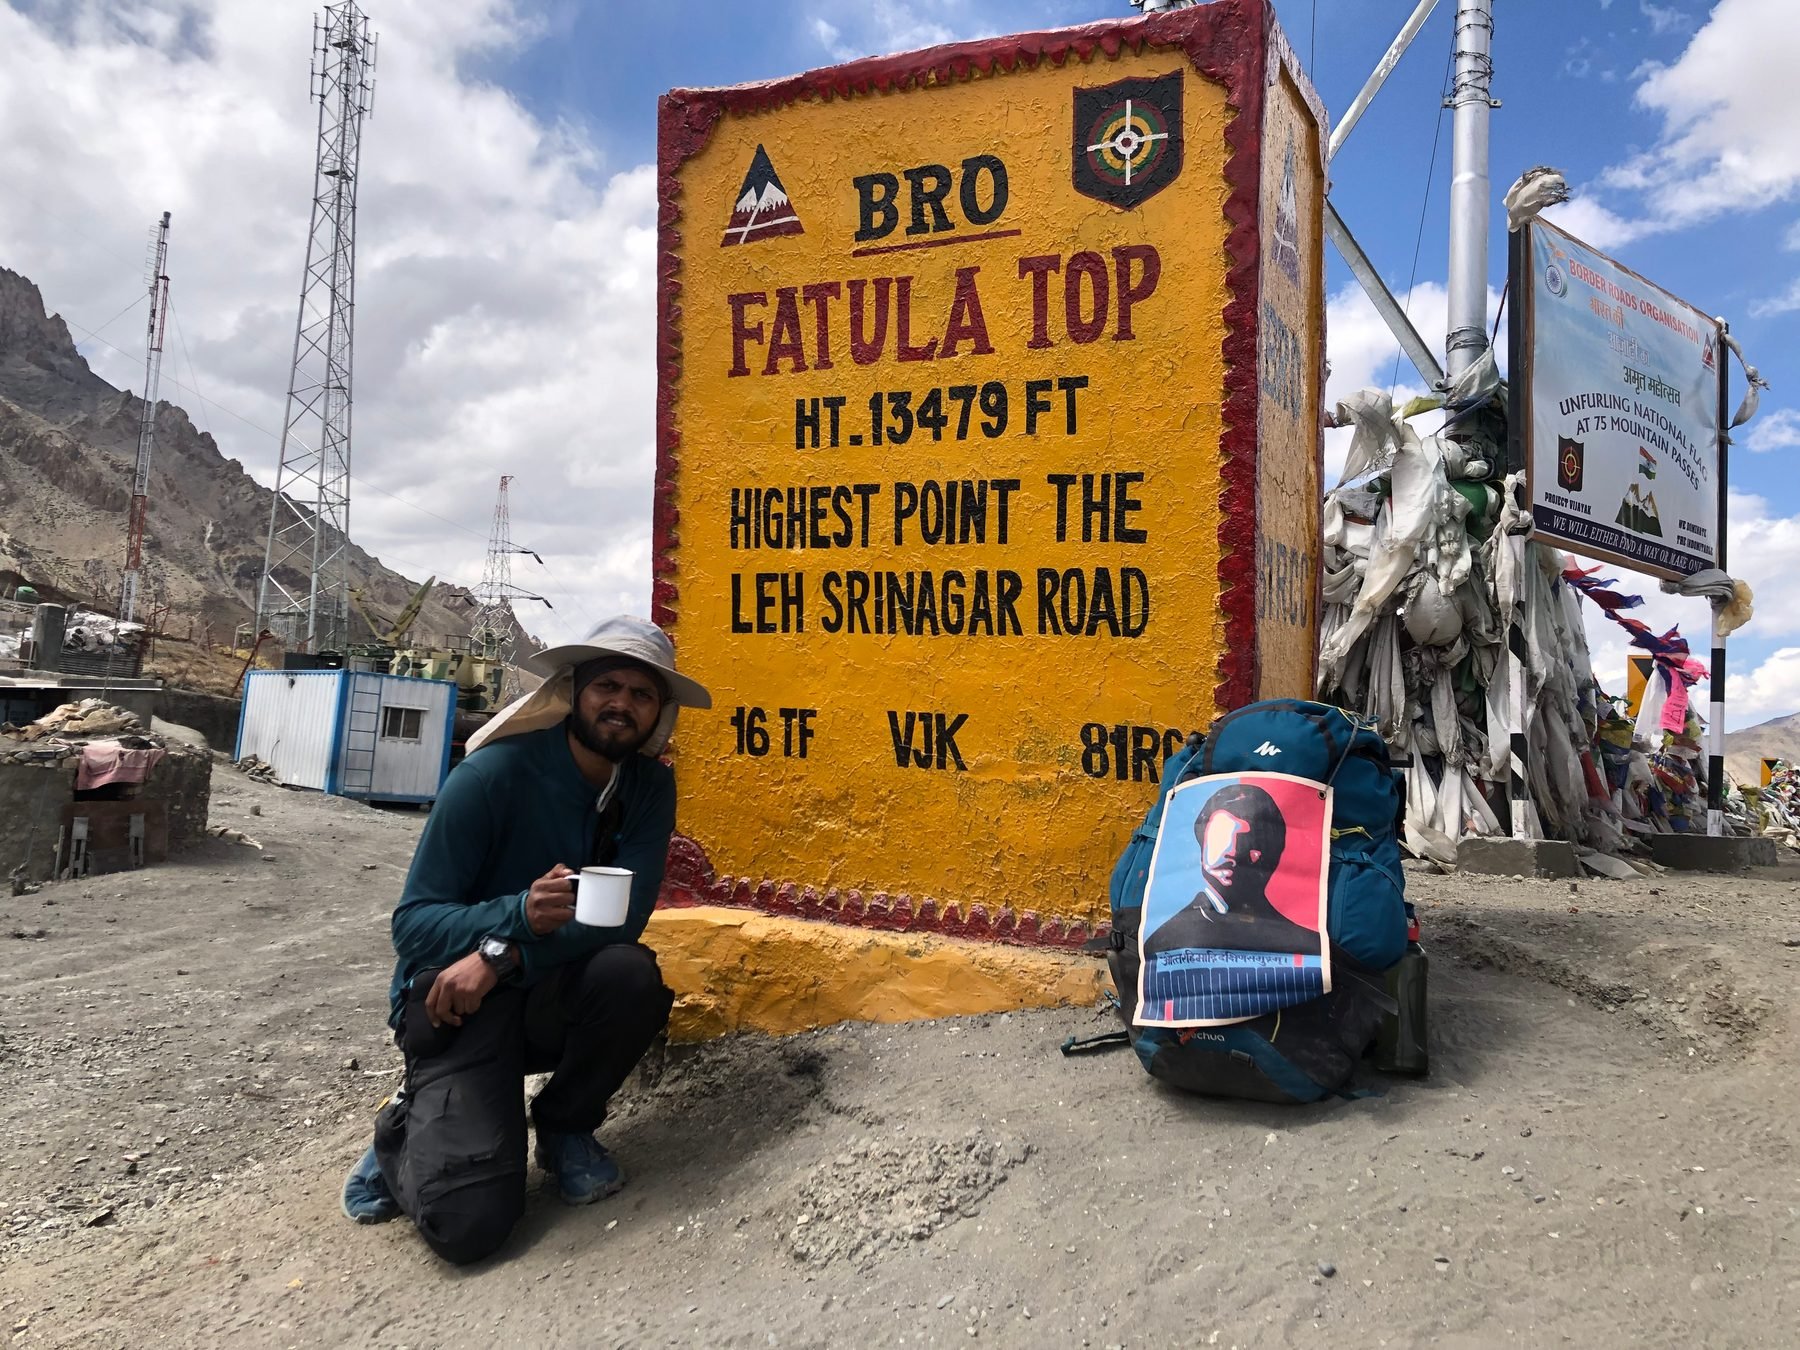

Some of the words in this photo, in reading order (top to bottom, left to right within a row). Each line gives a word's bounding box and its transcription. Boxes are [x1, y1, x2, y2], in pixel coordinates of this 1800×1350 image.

[853, 154, 1009, 242] BRO
[727, 266, 995, 378] FATULA
[1018, 244, 1162, 349] TOP
[1569, 258, 1606, 293] BORDER
[1608, 281, 1638, 310] ROADS
[1639, 299, 1699, 344] ORGANISATION
[1025, 375, 1089, 436] FT
[1623, 366, 1646, 395] अमृत
[1647, 374, 1681, 407] महोत्सव
[1559, 392, 1630, 416] UNFURLING
[1633, 401, 1687, 450] NATIONAL
[1688, 442, 1708, 482] FLAG
[1576, 417, 1591, 436] AT
[1594, 415, 1607, 431] 75
[1610, 415, 1669, 454] MOUNTAIN
[1671, 446, 1700, 491] PASSES
[730, 483, 881, 549] HIGHEST
[894, 479, 1021, 546] POINT
[1046, 471, 1148, 544] THE
[1544, 492, 1569, 509] PROJECT
[1569, 499, 1592, 515] VIJAYAK
[1552, 514, 1567, 531] WE
[1568, 519, 1588, 538] WILL
[1589, 526, 1619, 548] EITHER
[1619, 535, 1636, 553] FIND
[1636, 543, 1644, 556] A
[1643, 544, 1660, 560] WAY
[1660, 549, 1669, 563] OR
[1669, 552, 1688, 569] MAKE
[730, 573, 804, 634] LEH
[820, 569, 1024, 636] SRINAGAR
[1037, 567, 1150, 638] ROAD
[730, 706, 770, 758] 16
[777, 708, 817, 759] TF
[888, 710, 969, 772] VJK
